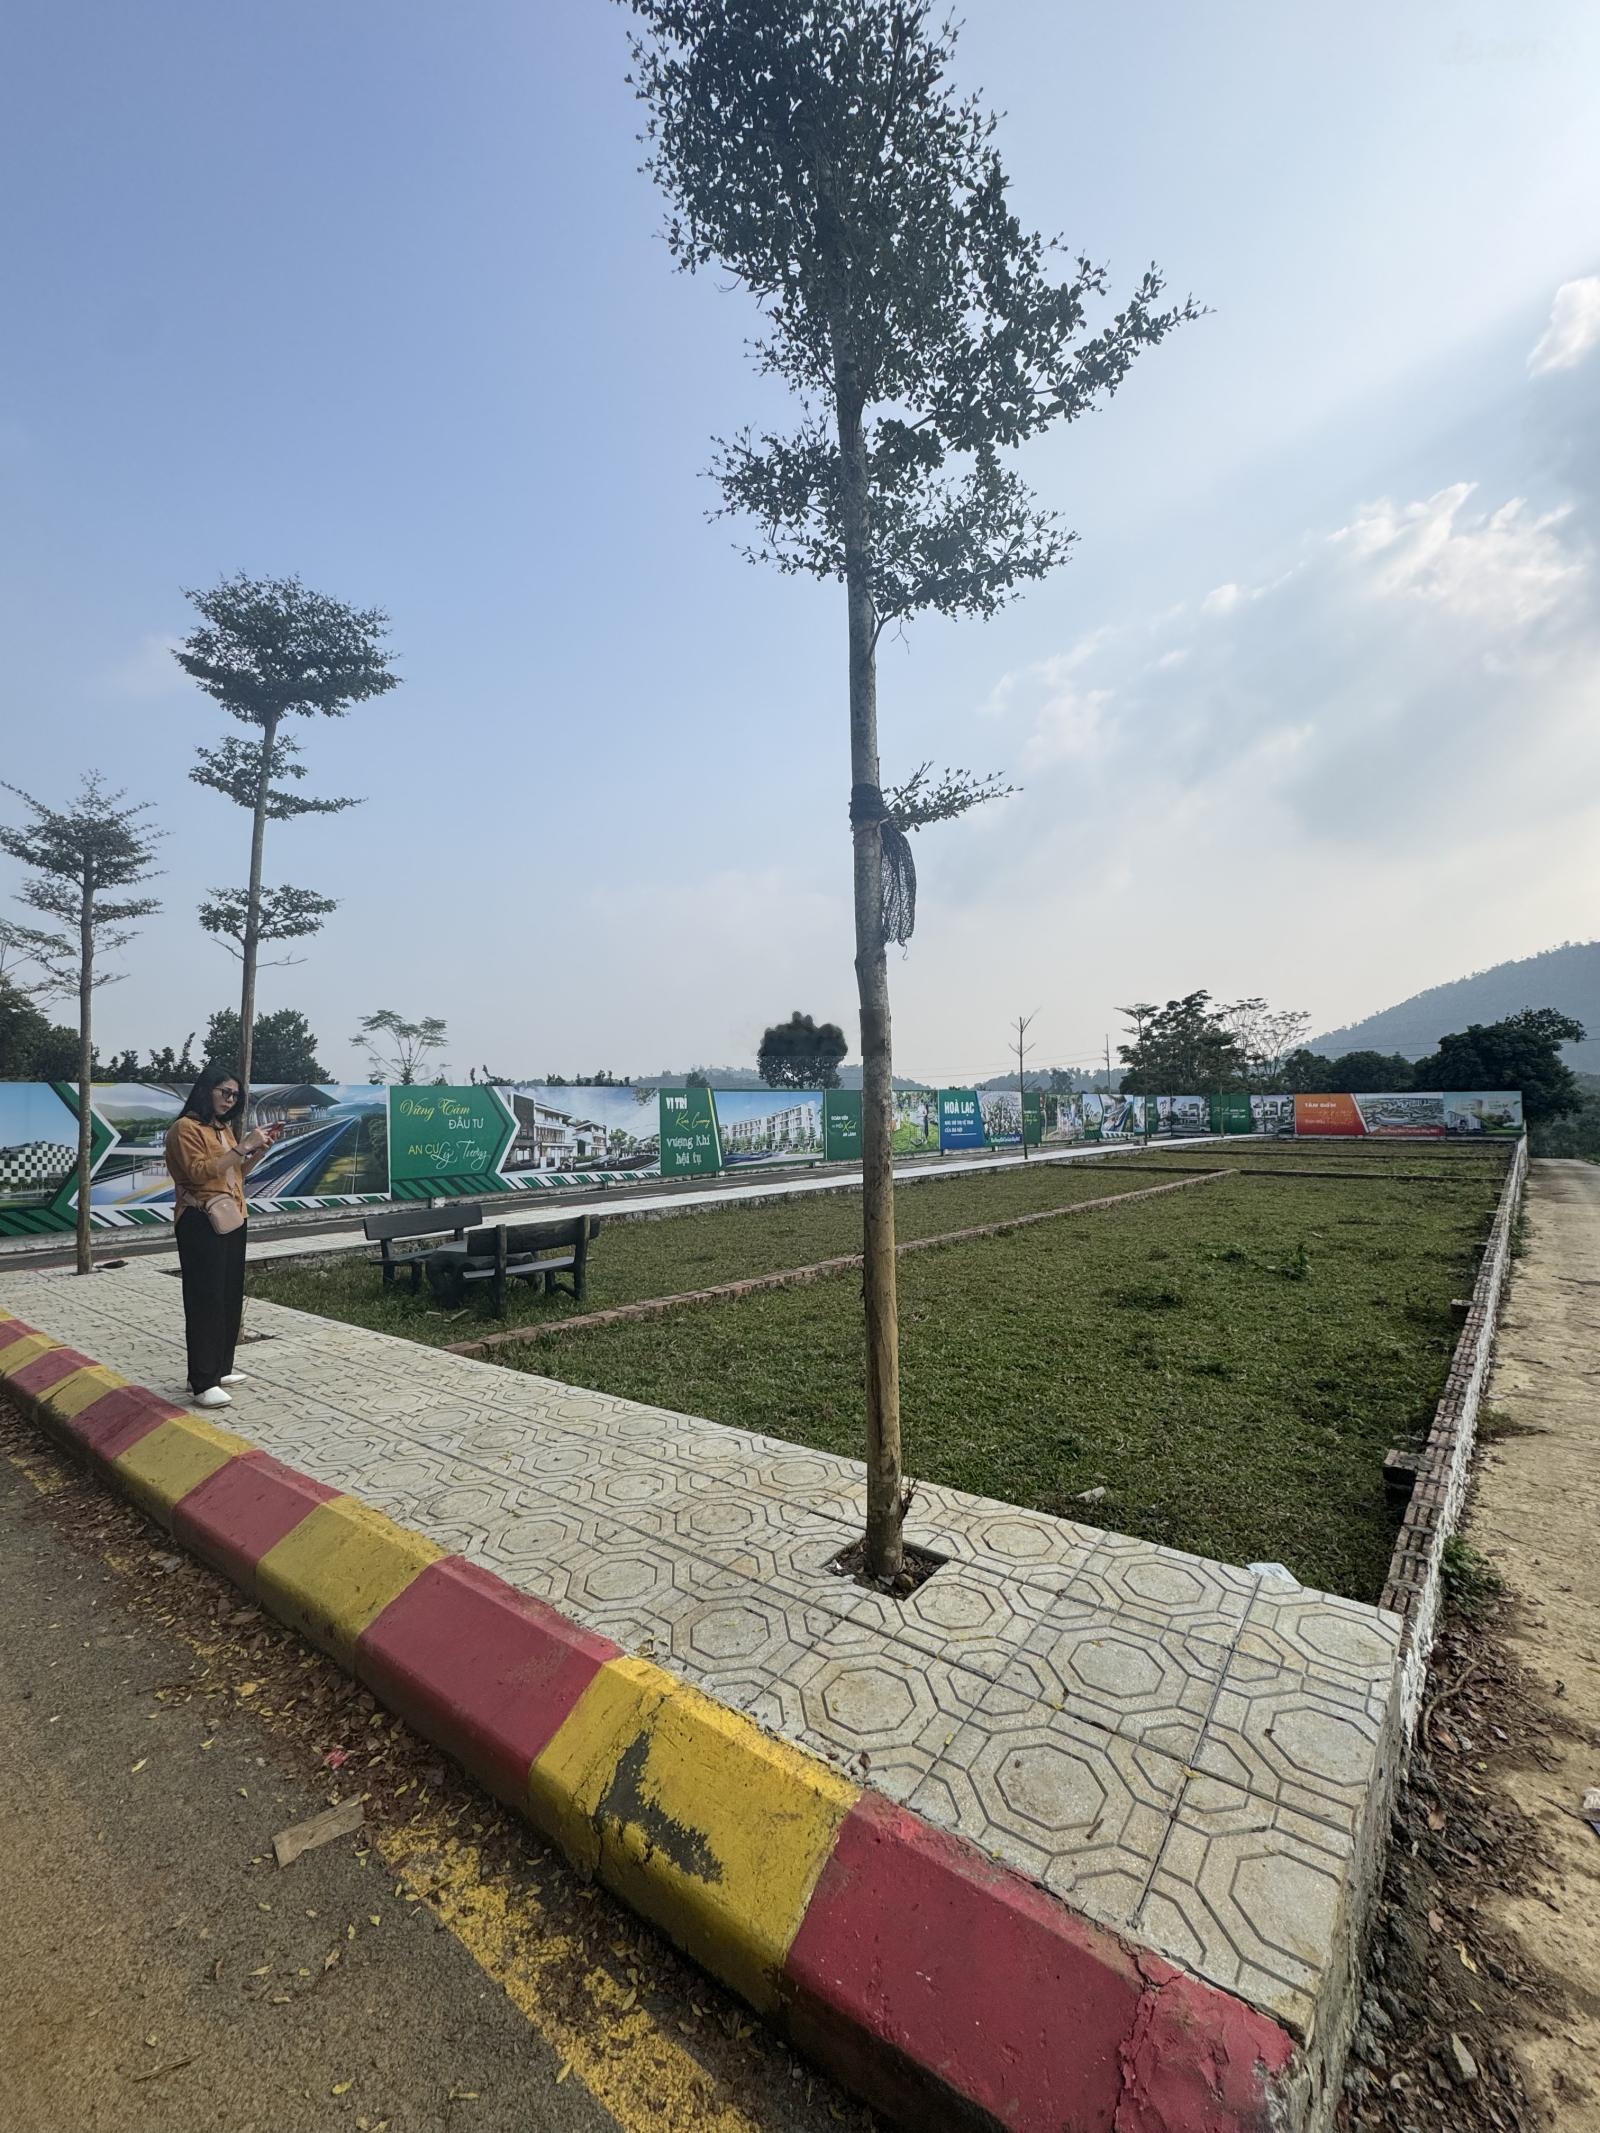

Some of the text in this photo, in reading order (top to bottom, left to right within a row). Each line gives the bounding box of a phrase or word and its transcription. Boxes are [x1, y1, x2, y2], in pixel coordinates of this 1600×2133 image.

[399, 1097, 436, 1122] Vững
[665, 1094, 688, 1113] VỊ TRÍ
[944, 1099, 975, 1117] HOÀ LẠC
[448, 1115, 485, 1130] ĐẦU TƯ
[408, 1144, 423, 1155] AN
[424, 1141, 440, 1155] CƯ
